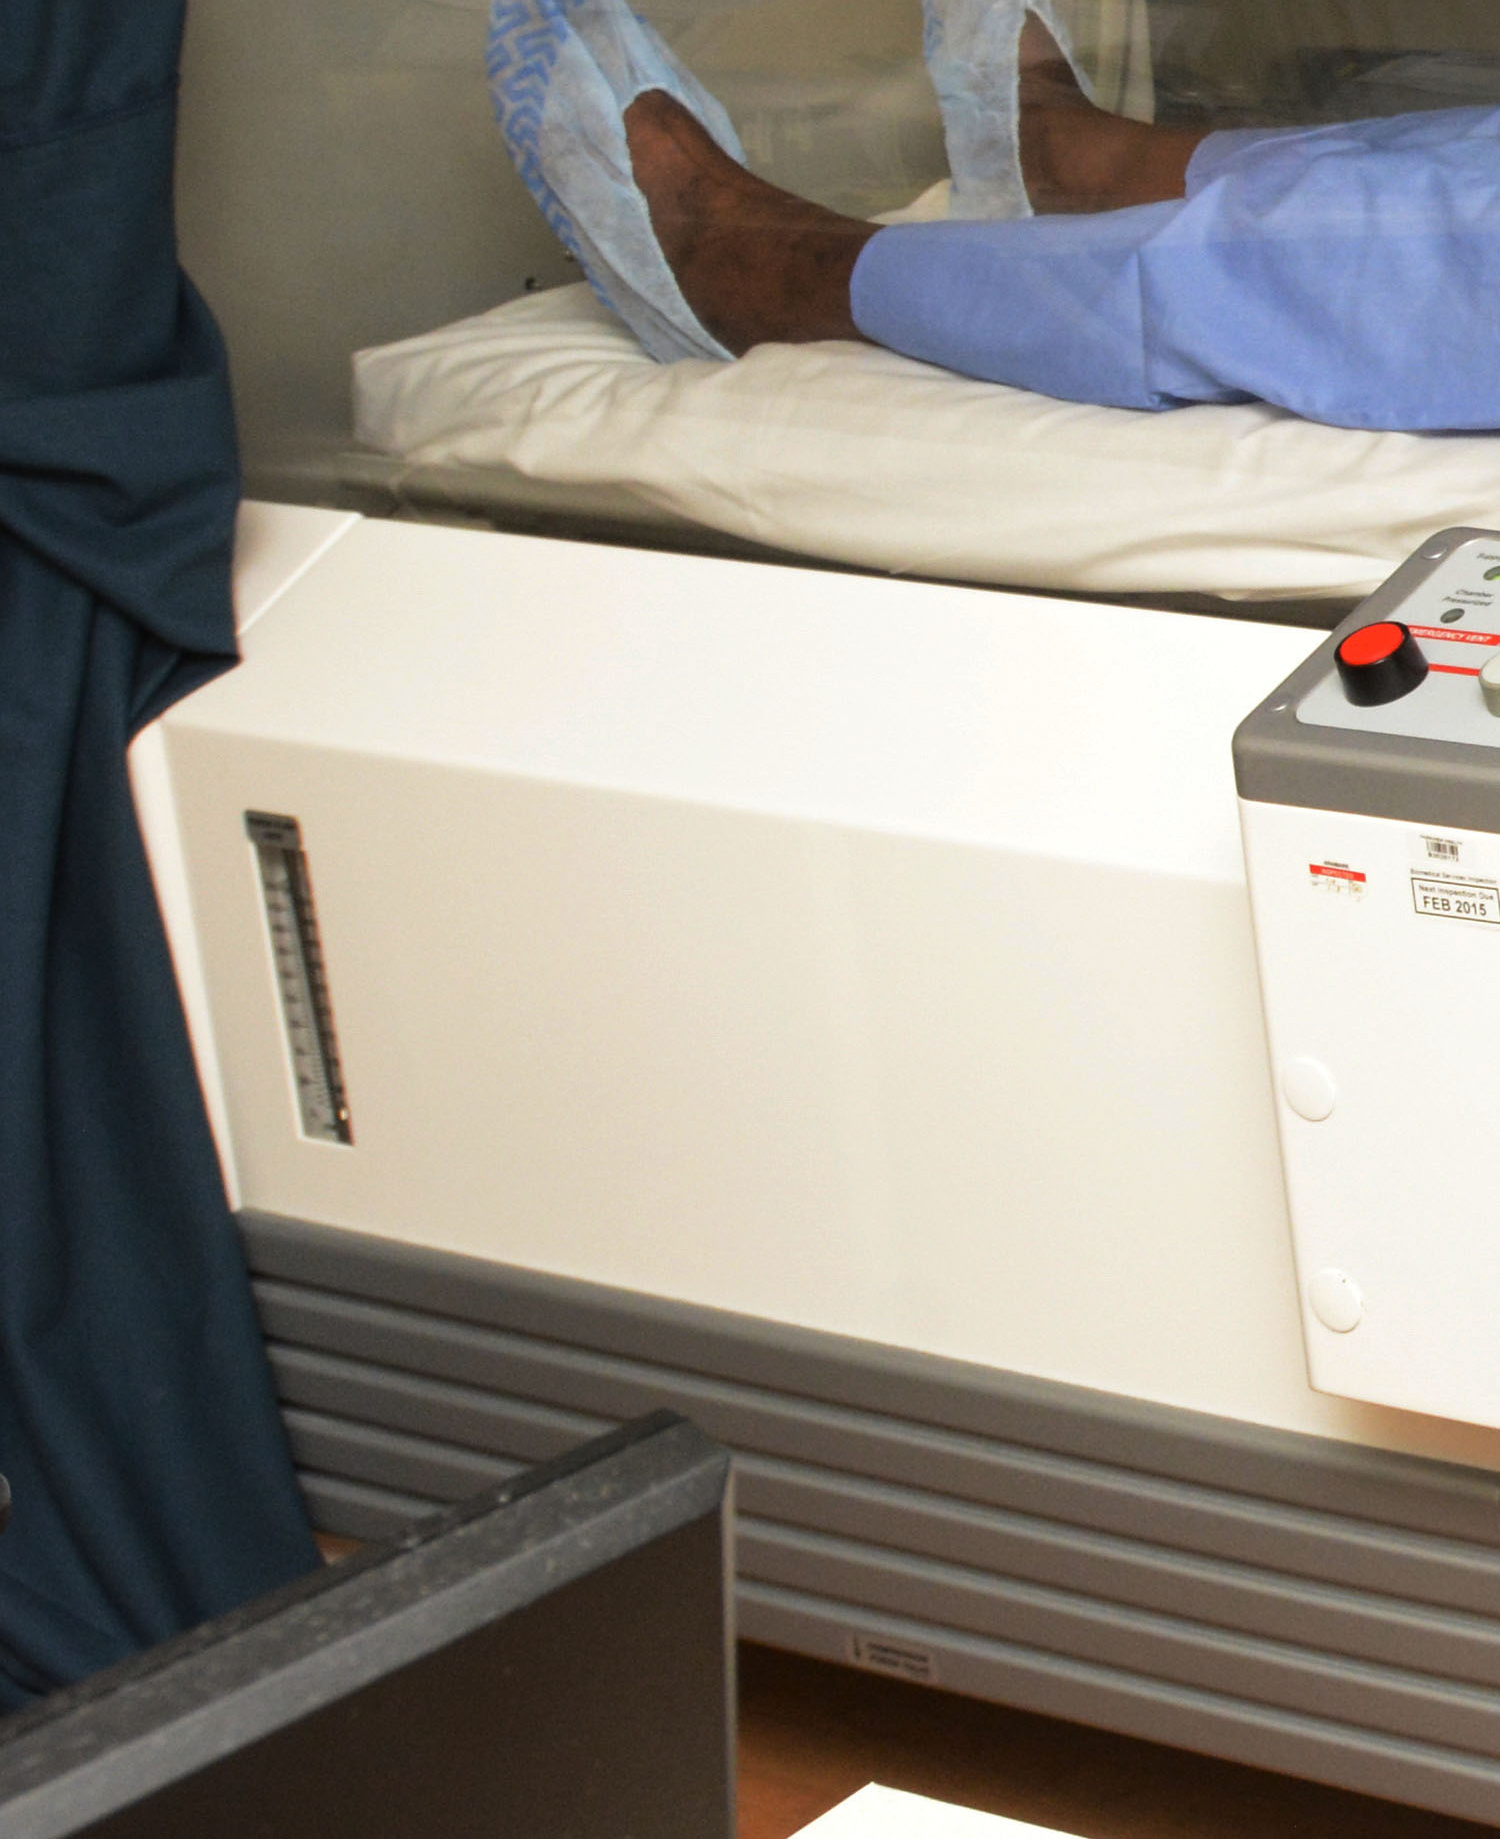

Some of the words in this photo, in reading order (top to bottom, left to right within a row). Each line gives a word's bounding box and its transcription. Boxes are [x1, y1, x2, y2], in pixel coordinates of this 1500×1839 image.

[1455, 589, 1494, 597] Chamber
[1419, 883, 1436, 893] Next
[1479, 891, 1494, 901] Due
[1423, 896, 1451, 912] FEB
[1455, 900, 1487, 917] 2015
